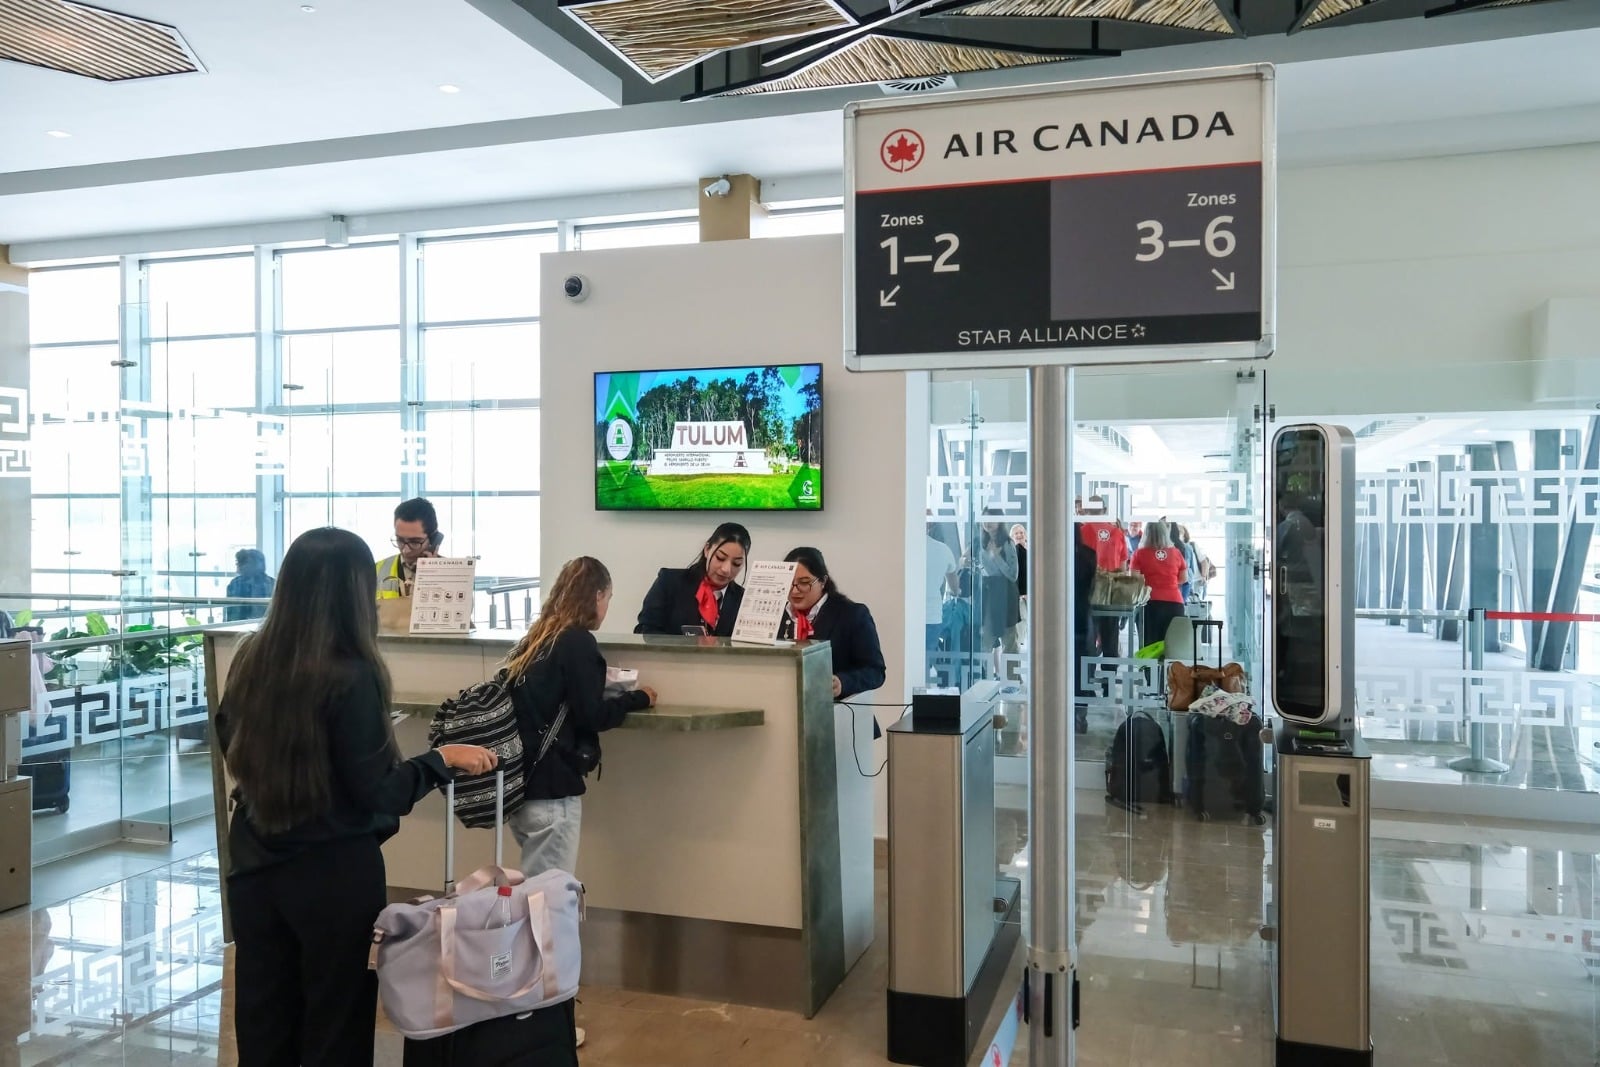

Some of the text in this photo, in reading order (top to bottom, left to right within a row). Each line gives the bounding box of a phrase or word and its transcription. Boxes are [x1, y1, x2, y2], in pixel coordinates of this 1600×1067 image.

[943, 111, 1234, 159] AIR CANADA
[1187, 191, 1237, 207] Zones
[881, 212, 924, 227] Zones
[957, 324, 1128, 345] STAR ALLIANCE
[676, 425, 743, 446] TULUM
